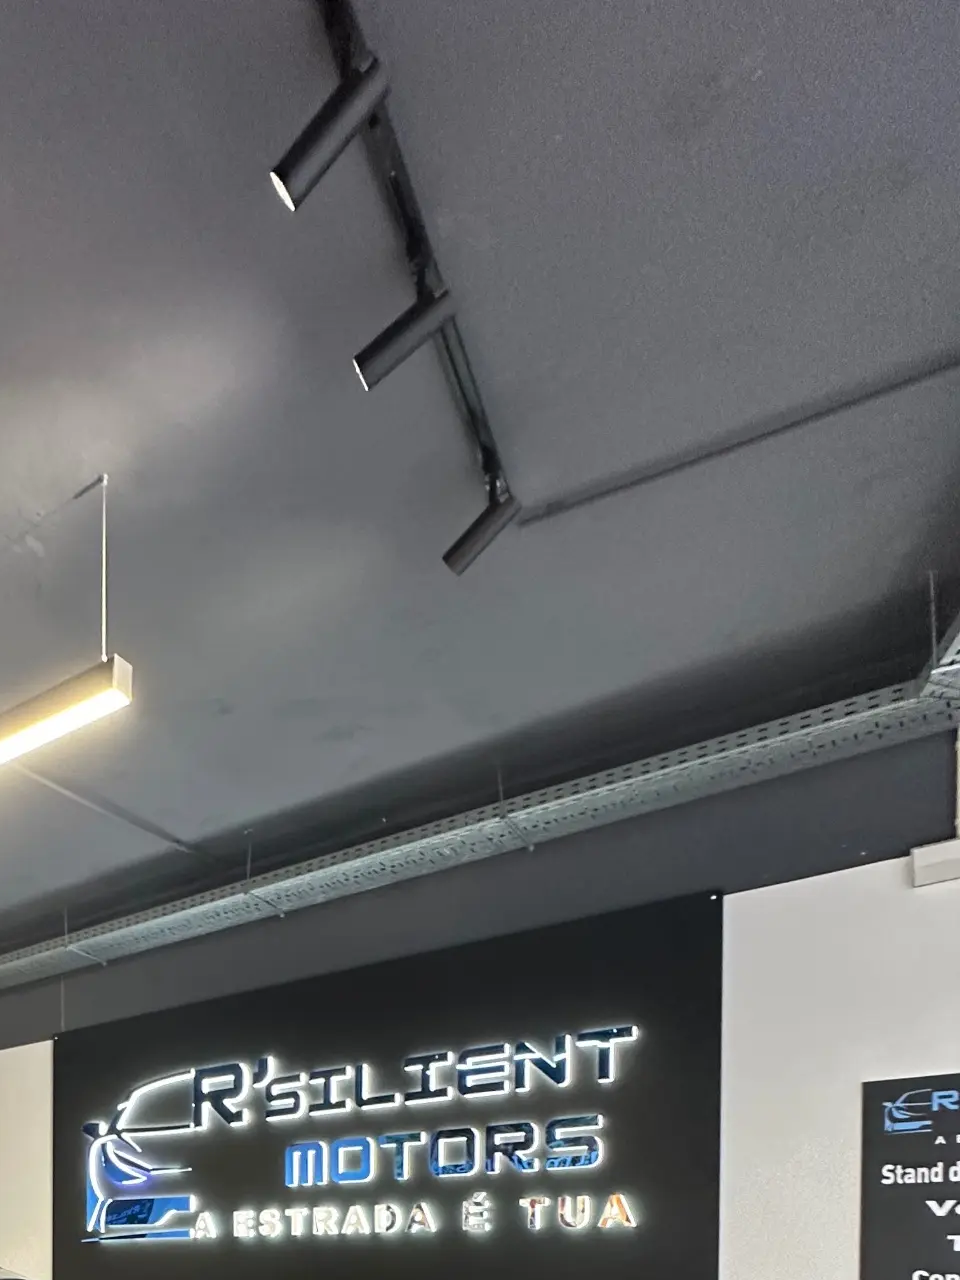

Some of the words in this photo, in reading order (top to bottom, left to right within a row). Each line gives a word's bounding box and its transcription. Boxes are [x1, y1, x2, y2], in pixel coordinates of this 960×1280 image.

[192, 1024, 639, 1128] R'SILIENT
[284, 1113, 605, 1188] MOTORS
[934, 1135, 947, 1145] A
[880, 1161, 944, 1185] Stand
[193, 1210, 218, 1240] A
[232, 1199, 438, 1239] ESTRADA
[462, 1191, 492, 1232] É
[518, 1191, 639, 1231] TUA
